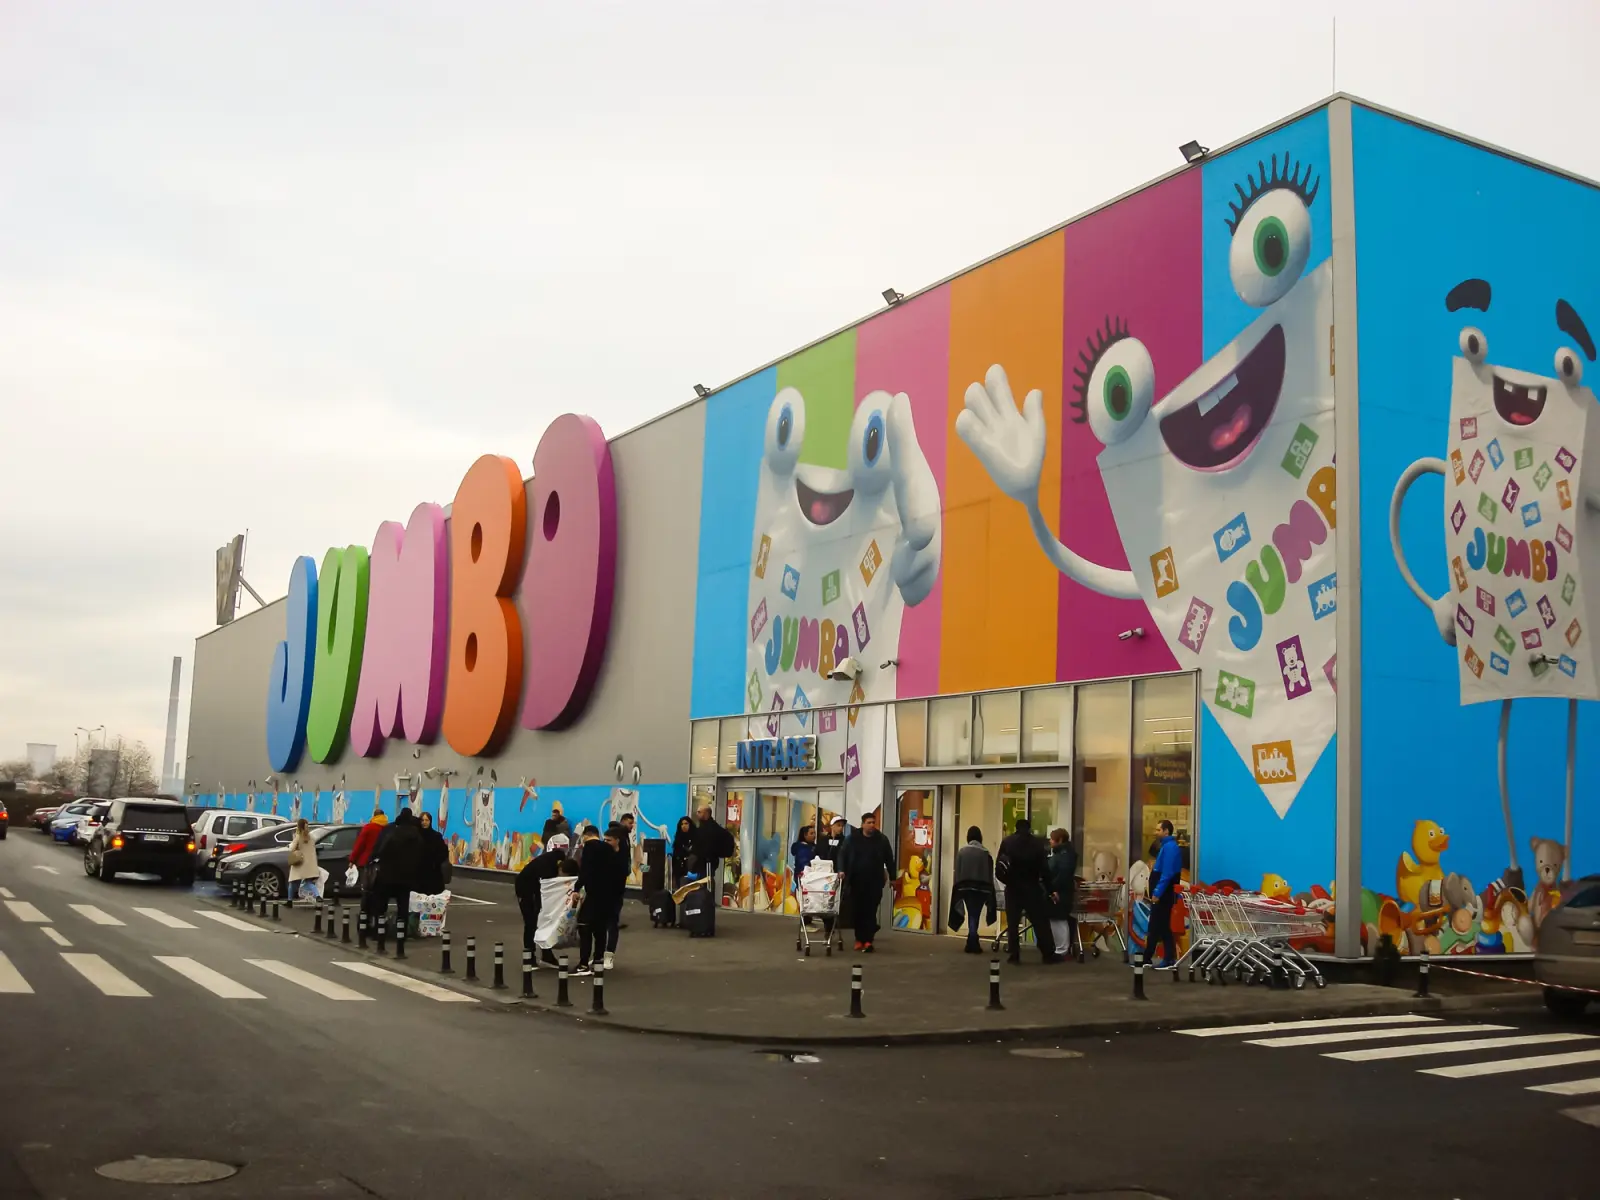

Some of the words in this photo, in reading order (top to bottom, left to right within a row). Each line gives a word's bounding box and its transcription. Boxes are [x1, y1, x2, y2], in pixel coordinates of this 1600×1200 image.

[1466, 527, 1558, 583] JUMBO
[266, 413, 617, 773] JUMBO
[765, 615, 849, 680] JUMBO
[736, 735, 813, 771] INTRARE
